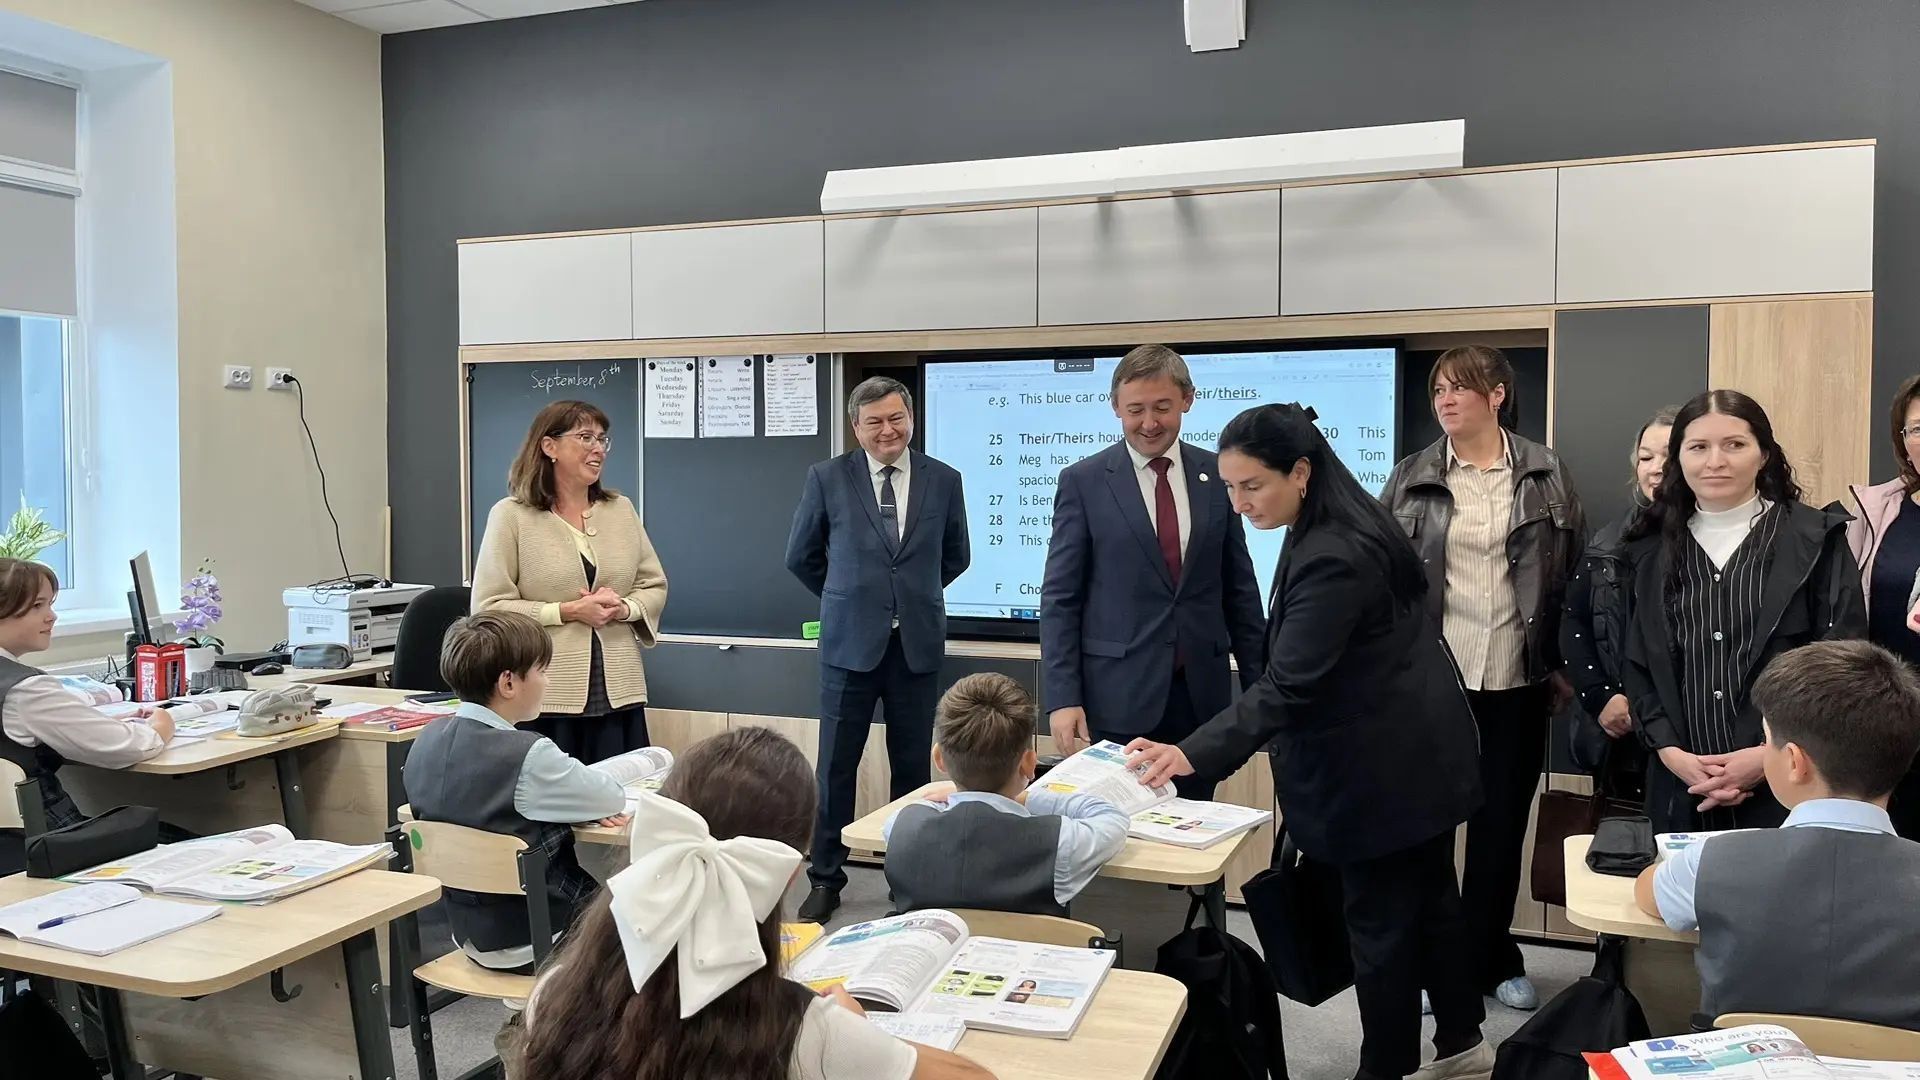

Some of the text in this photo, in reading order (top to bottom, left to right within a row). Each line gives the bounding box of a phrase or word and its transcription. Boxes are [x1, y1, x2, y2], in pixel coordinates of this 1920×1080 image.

[531, 363, 596, 394] September,
[658, 392, 685, 400] Thursday
[988, 386, 1261, 407] e.g. This blue car ov eir/theirs.
[661, 401, 680, 409] Friday
[658, 410, 684, 418] Saturday
[989, 433, 1003, 445] 25
[1019, 432, 1094, 445] Their/Theirs
[1098, 431, 1125, 443] hous
[1322, 426, 1386, 439] 30 This
[989, 454, 1003, 465] 26
[1019, 453, 1041, 467] Meg
[1050, 452, 1069, 465] has
[1357, 448, 1386, 461] Tom
[1019, 474, 1058, 488] spaciou
[1357, 471, 1387, 483] Wha
[989, 494, 1003, 505] 27
[1020, 494, 1028, 506] Is
[989, 514, 1003, 525] 28
[1019, 515, 1039, 526] Are
[989, 534, 1003, 545] 29
[1019, 534, 1042, 546] This
[995, 583, 1041, 595] F Cho
[1689, 1035, 1724, 1045] Who
[1727, 1031, 1751, 1040] are
